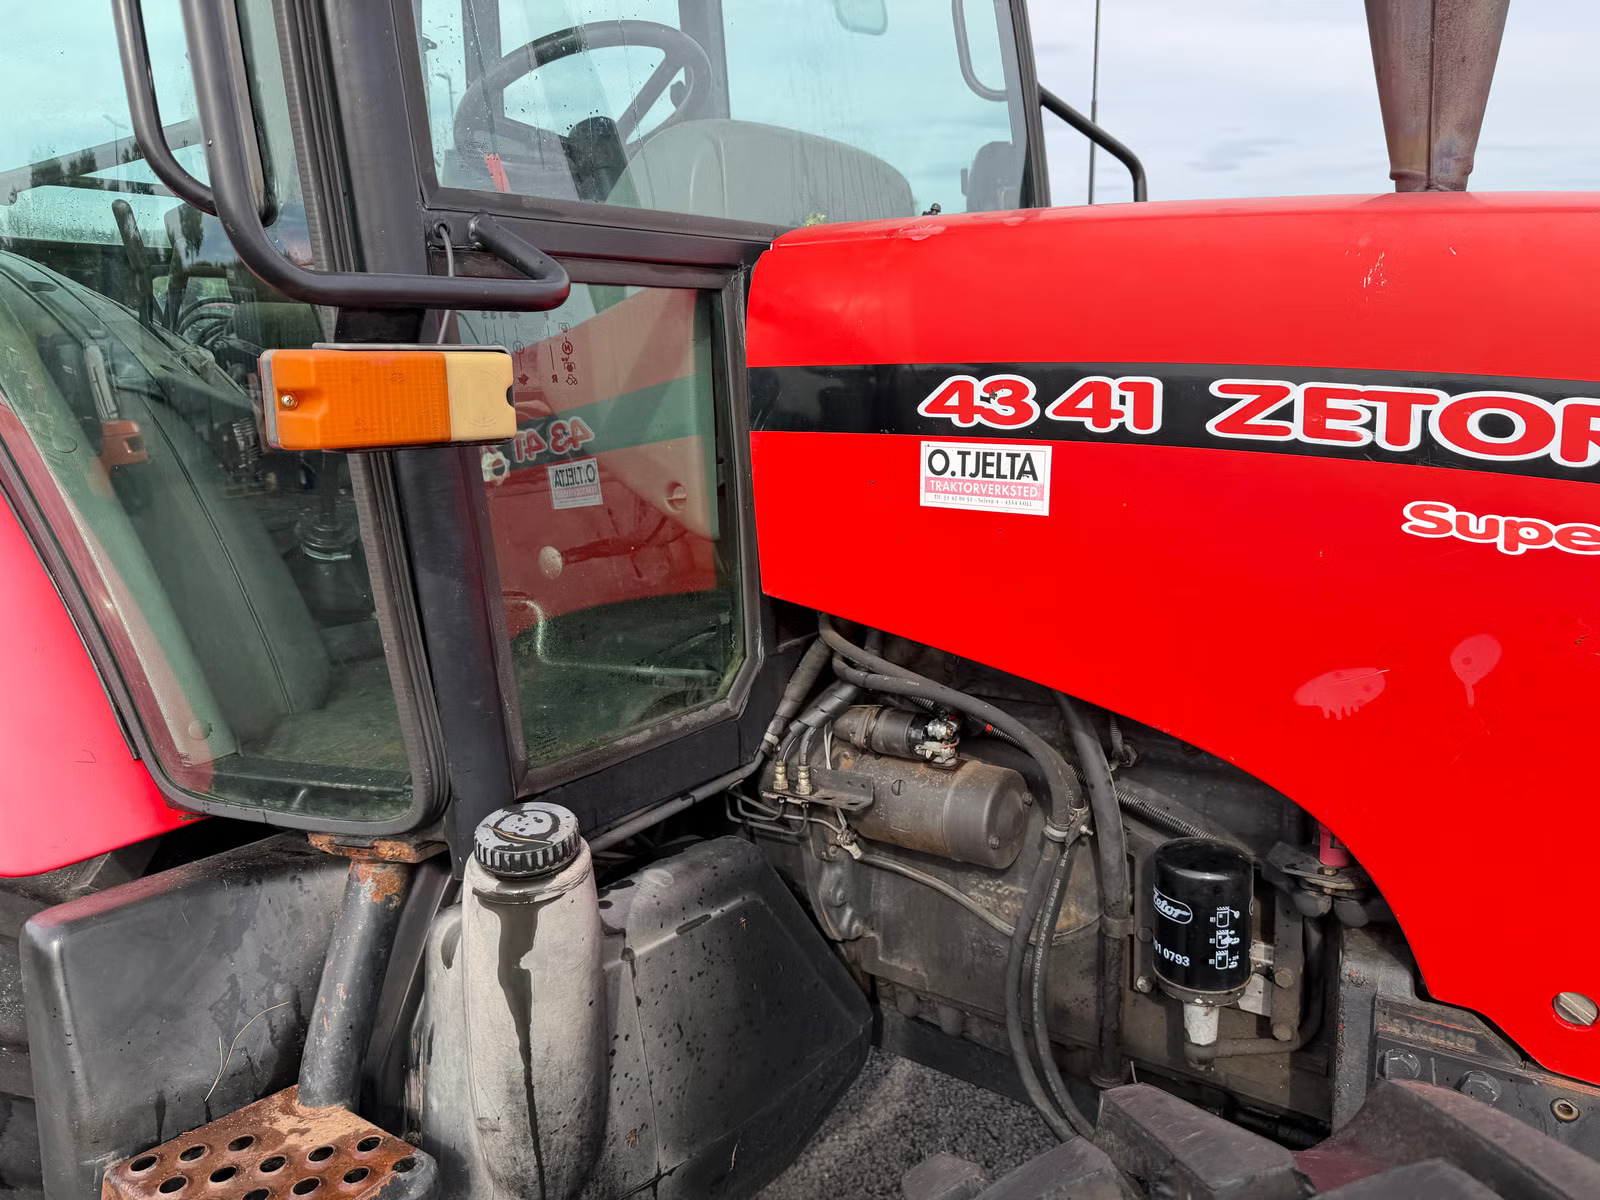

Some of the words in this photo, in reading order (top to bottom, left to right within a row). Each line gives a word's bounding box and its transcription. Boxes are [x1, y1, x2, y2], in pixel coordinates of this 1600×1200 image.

[927, 448, 1039, 481] O.TJELTA
[930, 479, 1038, 498] TRAKTORVERKSTED
[1163, 947, 1190, 967] 0793
